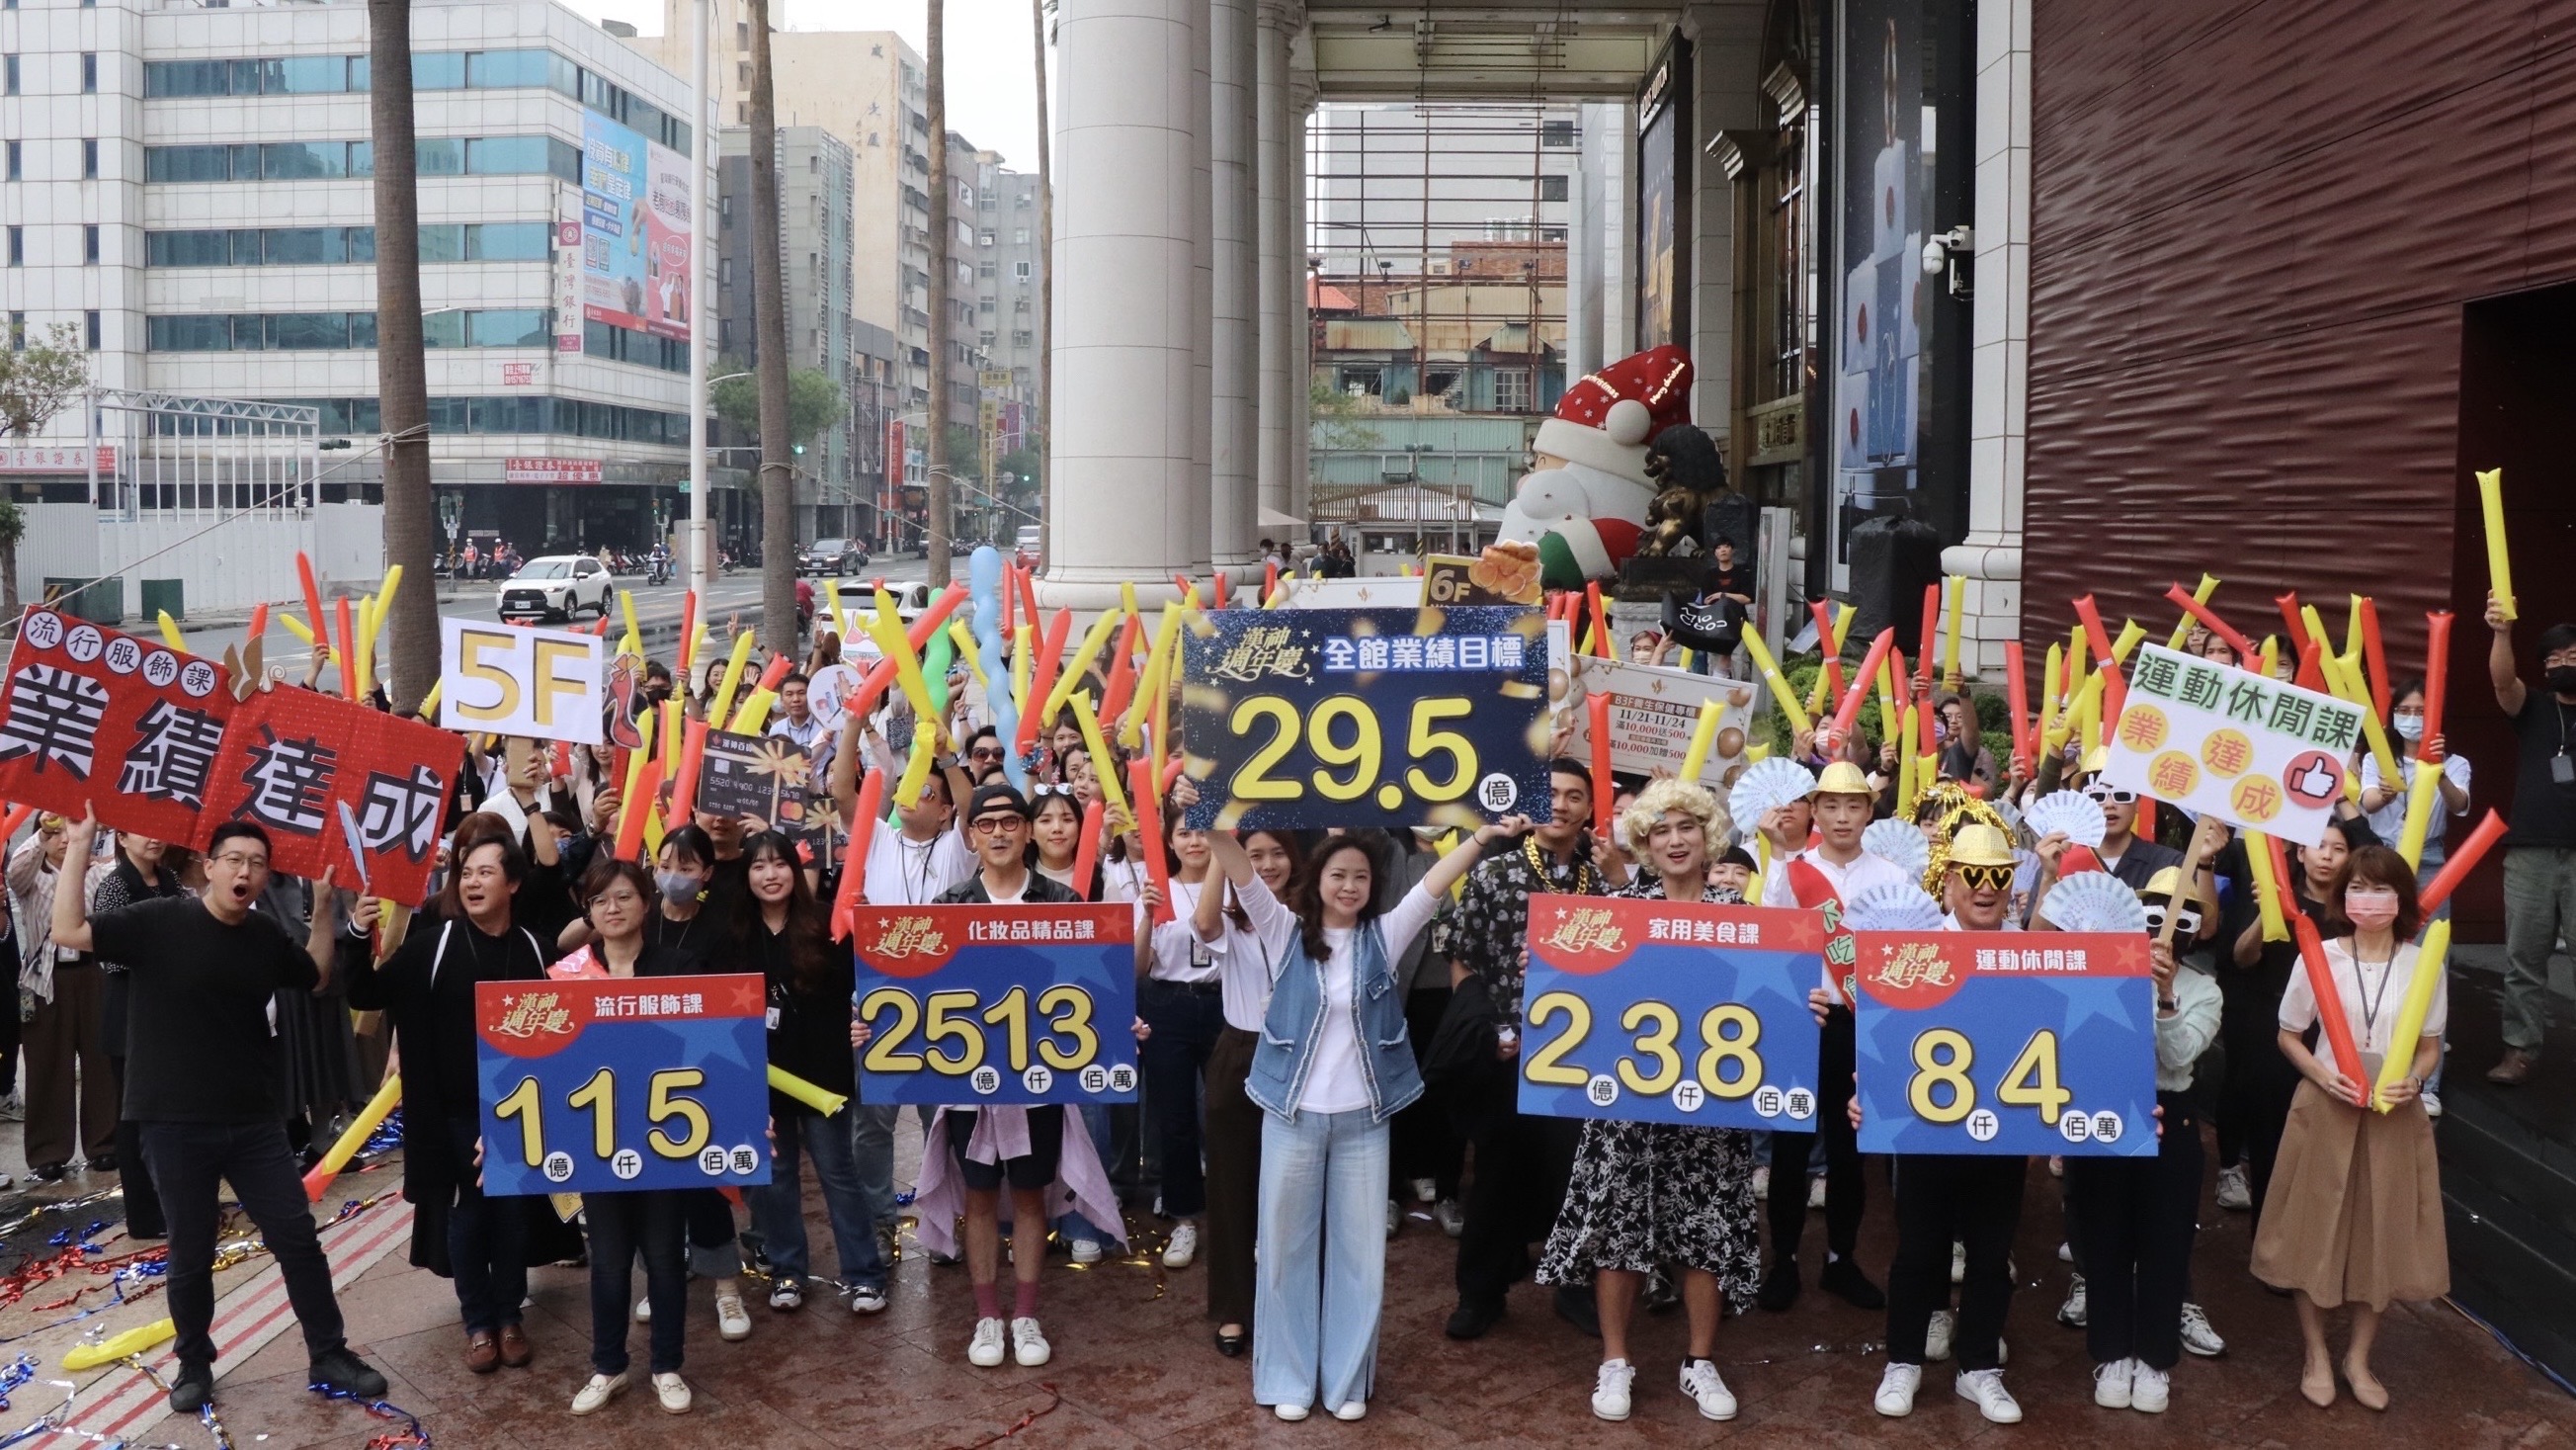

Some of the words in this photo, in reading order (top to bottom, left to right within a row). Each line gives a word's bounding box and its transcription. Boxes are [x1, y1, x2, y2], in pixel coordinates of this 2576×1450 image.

[563, 252, 576, 328] 臺灣銀行
[1431, 569, 1471, 603] 6F
[29, 615, 213, 692] 流行服飾課
[1324, 637, 1523, 670] 全館業績目標
[456, 629, 591, 726] 5F
[2134, 652, 2359, 750] 運動休閒課
[1620, 709, 1686, 728] 11/21-11/24
[0, 662, 444, 864] 業績達成
[967, 919, 1095, 941] 化妝品精品課
[1648, 917, 1760, 944] 家用美食課
[1975, 949, 2088, 972] 運動休閒課
[594, 992, 704, 1018] 流行服飾課
